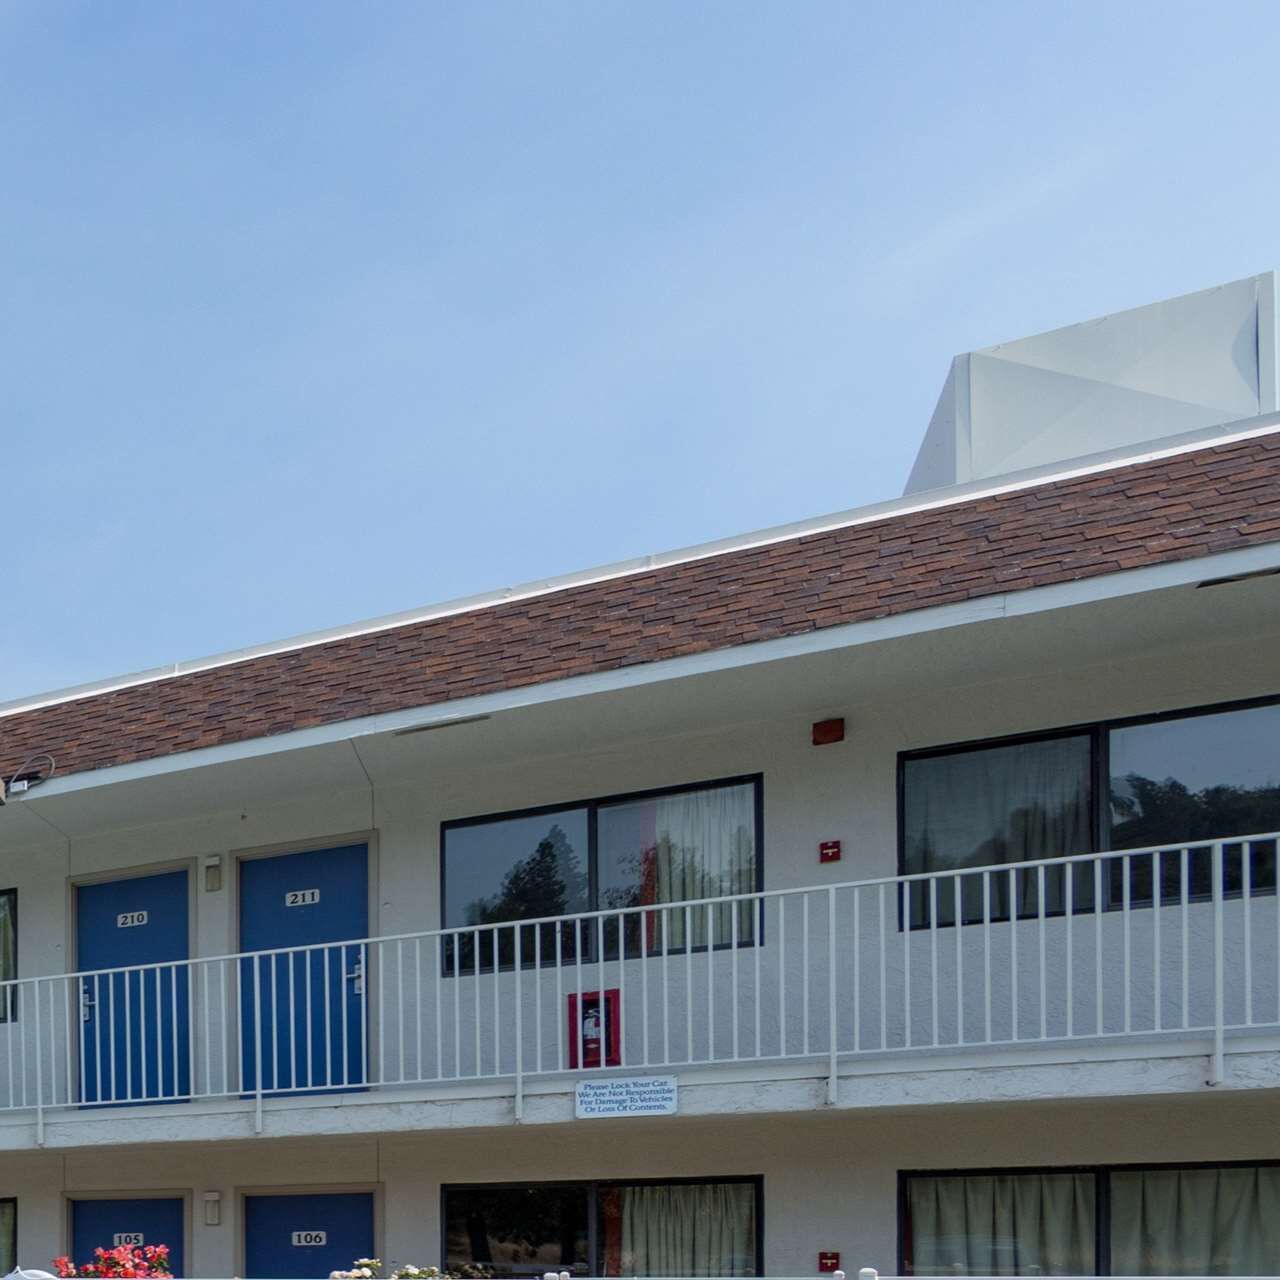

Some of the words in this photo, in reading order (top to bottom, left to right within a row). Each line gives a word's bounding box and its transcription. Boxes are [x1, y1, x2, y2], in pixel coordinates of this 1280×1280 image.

[289, 891, 316, 904] 211
[120, 912, 145, 926] 210
[584, 1083, 609, 1091] Please
[610, 1082, 631, 1090] Lock
[632, 1081, 650, 1089] Your
[625, 1087, 675, 1098] Responsible
[595, 1098, 628, 1107] Damage
[629, 1096, 638, 1104] To
[638, 1095, 673, 1104] Vehicles
[598, 1105, 616, 1113] Loss
[616, 1104, 628, 1112] Of
[116, 1234, 141, 1246] 105
[295, 1233, 323, 1245] 106
